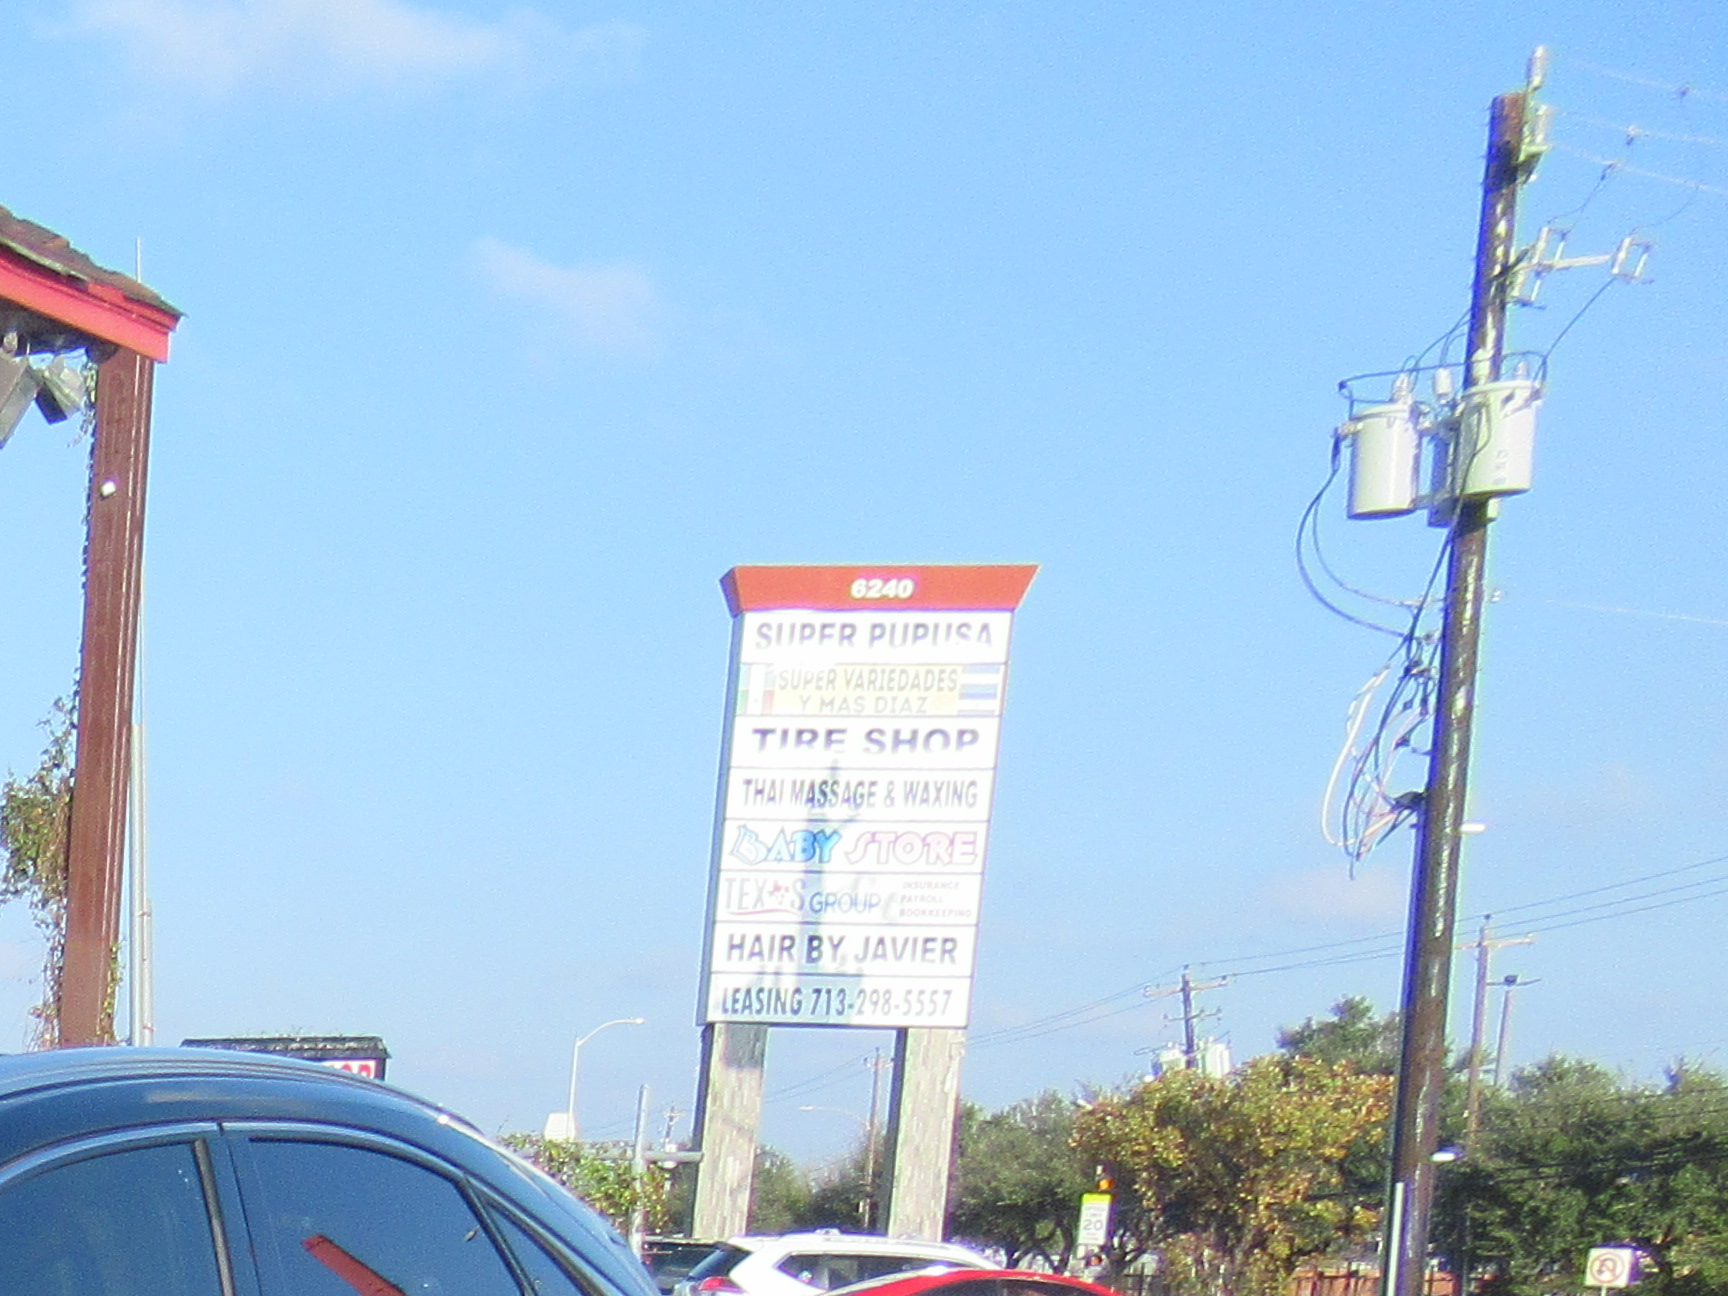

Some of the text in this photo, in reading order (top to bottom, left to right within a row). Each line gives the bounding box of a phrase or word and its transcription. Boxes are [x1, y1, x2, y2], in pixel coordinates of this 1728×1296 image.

[849, 577, 915, 599] 6240
[754, 622, 994, 649] SUPER PUPUSA
[777, 668, 959, 693] SUPER VARIEDADES
[819, 696, 867, 714] MAS
[874, 696, 929, 715] DIAZ
[751, 728, 981, 755] TIRE SHOP
[742, 779, 979, 809] THAI MASSAGE & WAXING
[728, 823, 979, 867] BABY STORE
[809, 891, 883, 916] GROUP
[725, 933, 959, 965] HAIR BY JAVIER
[721, 986, 954, 1018] LEASING 713-298-5557
